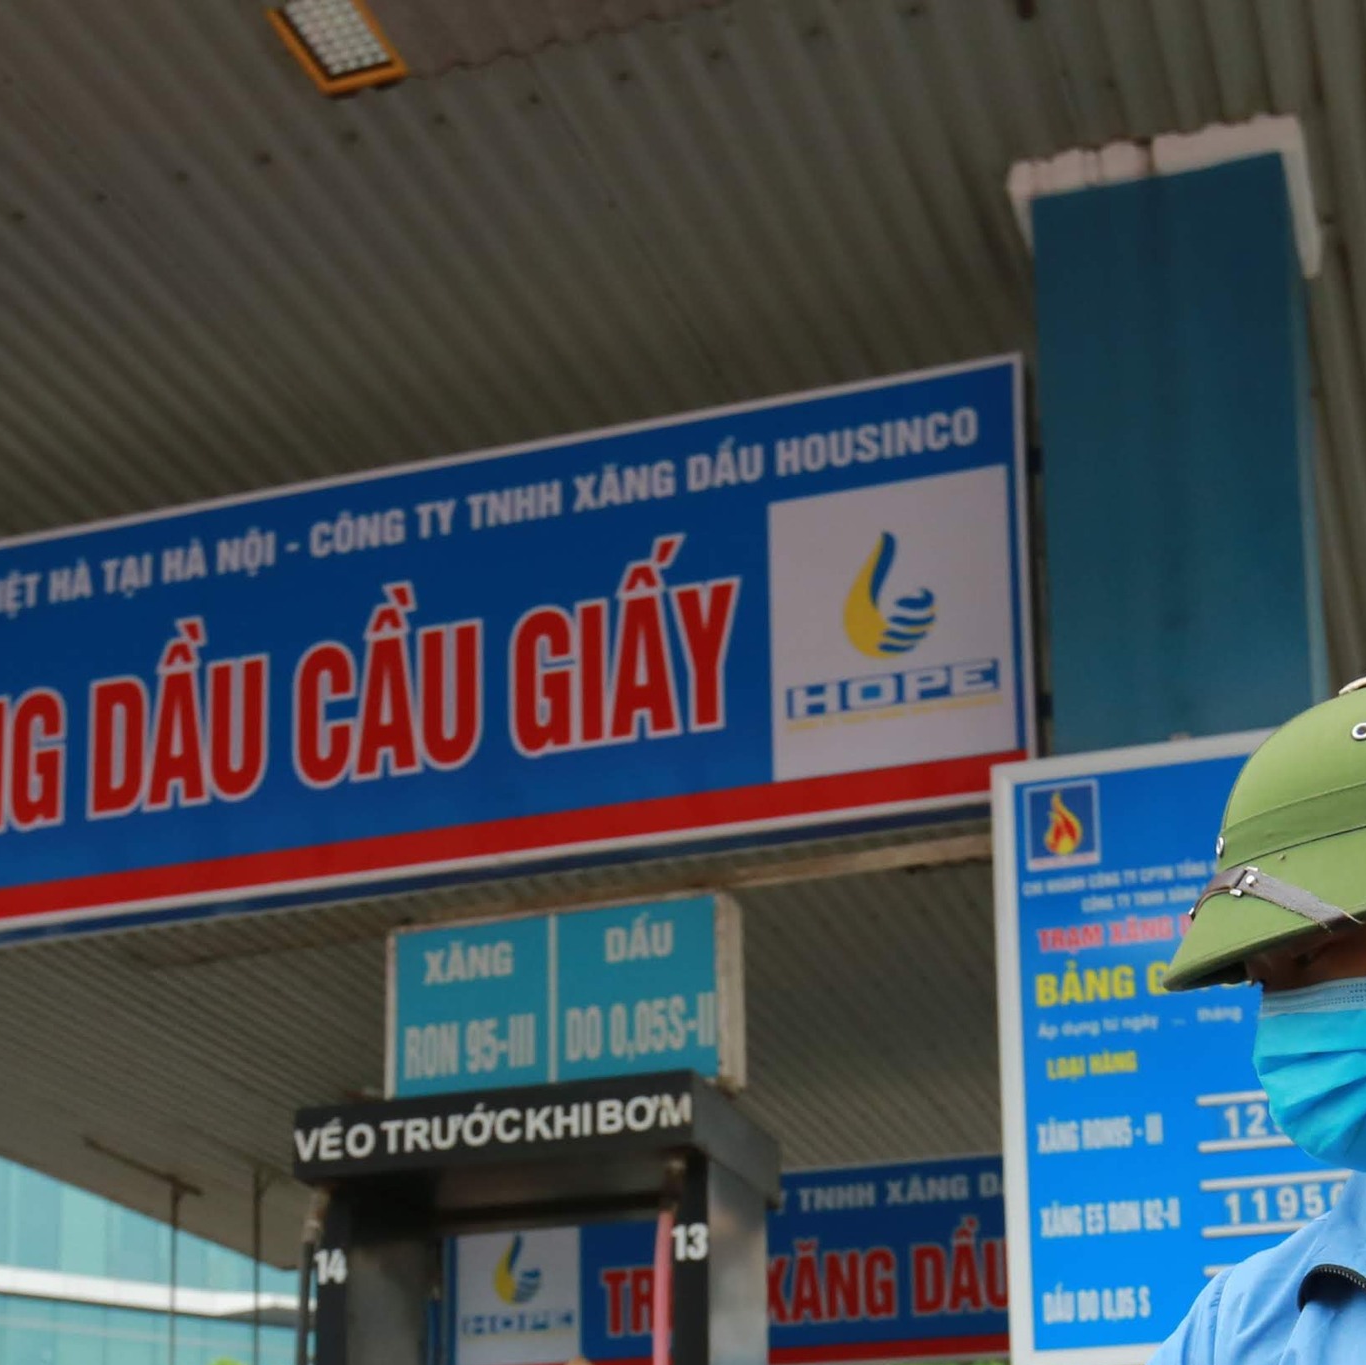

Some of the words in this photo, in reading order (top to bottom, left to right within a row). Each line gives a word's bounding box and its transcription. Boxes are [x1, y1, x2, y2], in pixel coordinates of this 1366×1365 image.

[48, 557, 94, 603] HÀ
[101, 553, 152, 600] TẠI
[161, 537, 208, 585] HÀ
[216, 526, 276, 578] NỘI
[308, 507, 406, 558] CÔNG
[414, 498, 457, 539] TY
[465, 479, 562, 531] TNHH
[572, 459, 675, 513] XĂNG
[774, 405, 979, 477] HOUSINCO
[86, 616, 270, 821] DẦU
[291, 581, 484, 790] CẦU
[509, 533, 742, 759] GIẤY
[786, 658, 1000, 720] HOPE
[1038, 922, 1103, 955] TRẠM
[1109, 915, 1174, 947] XĂNG
[423, 941, 514, 985] XĂNG
[1036, 959, 1135, 1008] BẢNG
[404, 1021, 459, 1080] RON
[564, 1004, 603, 1062] DO
[1046, 1054, 1086, 1082] LOẠI
[1089, 1048, 1138, 1075] HÀNG
[1224, 1103, 1275, 1138] 12
[798, 1182, 876, 1213] TNHH
[886, 1173, 969, 1204] XĂNG
[671, 1223, 710, 1261] 13
[314, 1248, 348, 1285] 14
[767, 1236, 896, 1325] XĂNG
